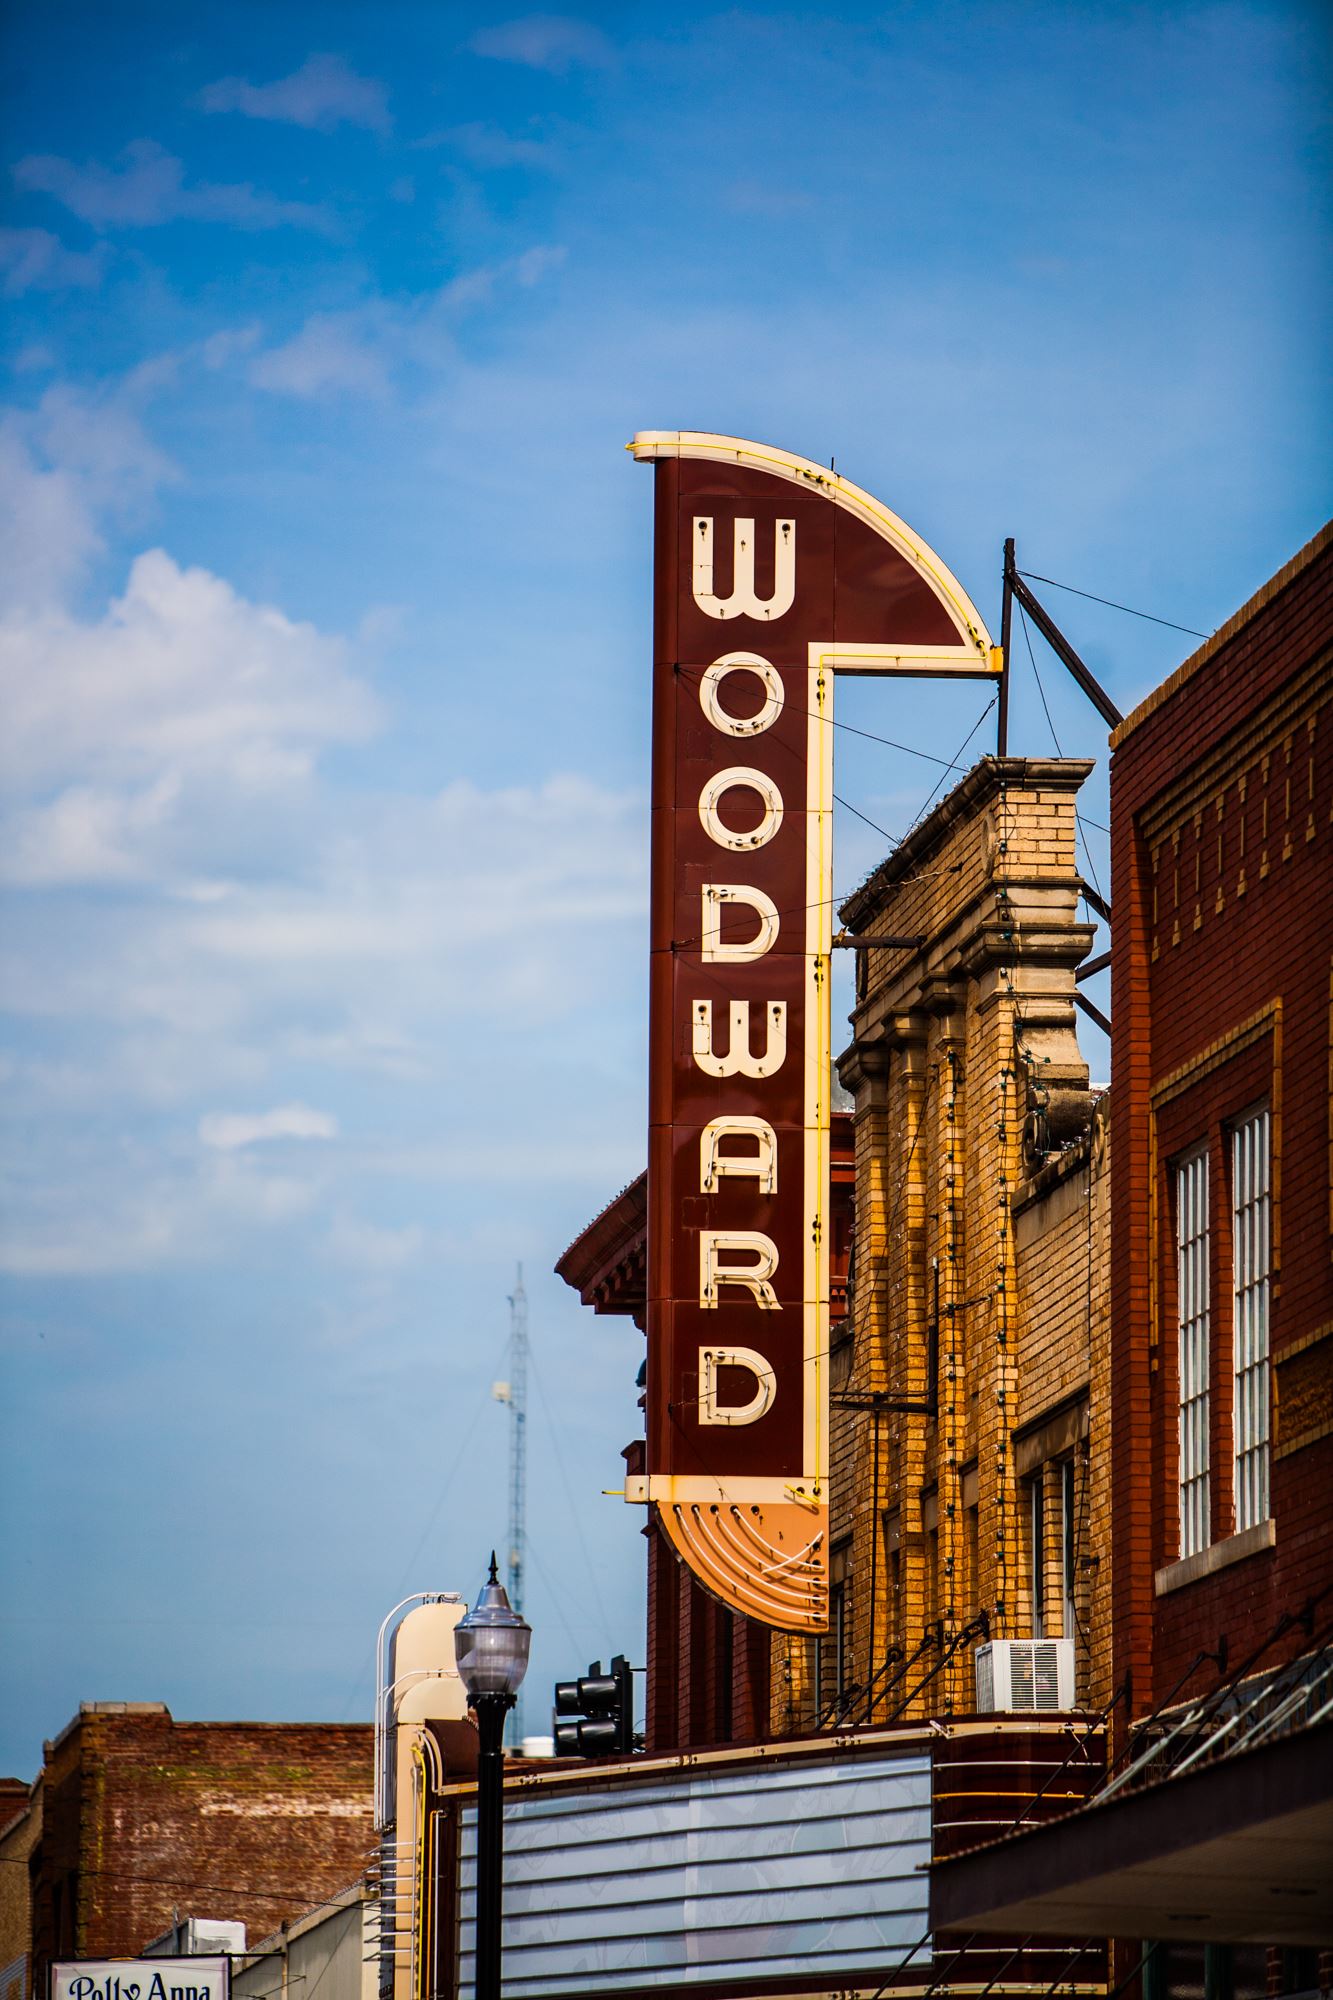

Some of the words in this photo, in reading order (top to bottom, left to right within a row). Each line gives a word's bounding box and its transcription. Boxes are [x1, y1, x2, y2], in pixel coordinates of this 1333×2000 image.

[692, 517, 796, 1426] WOODWARD
[69, 1975, 140, 2000] Polly
[147, 1972, 210, 2000] Anna
